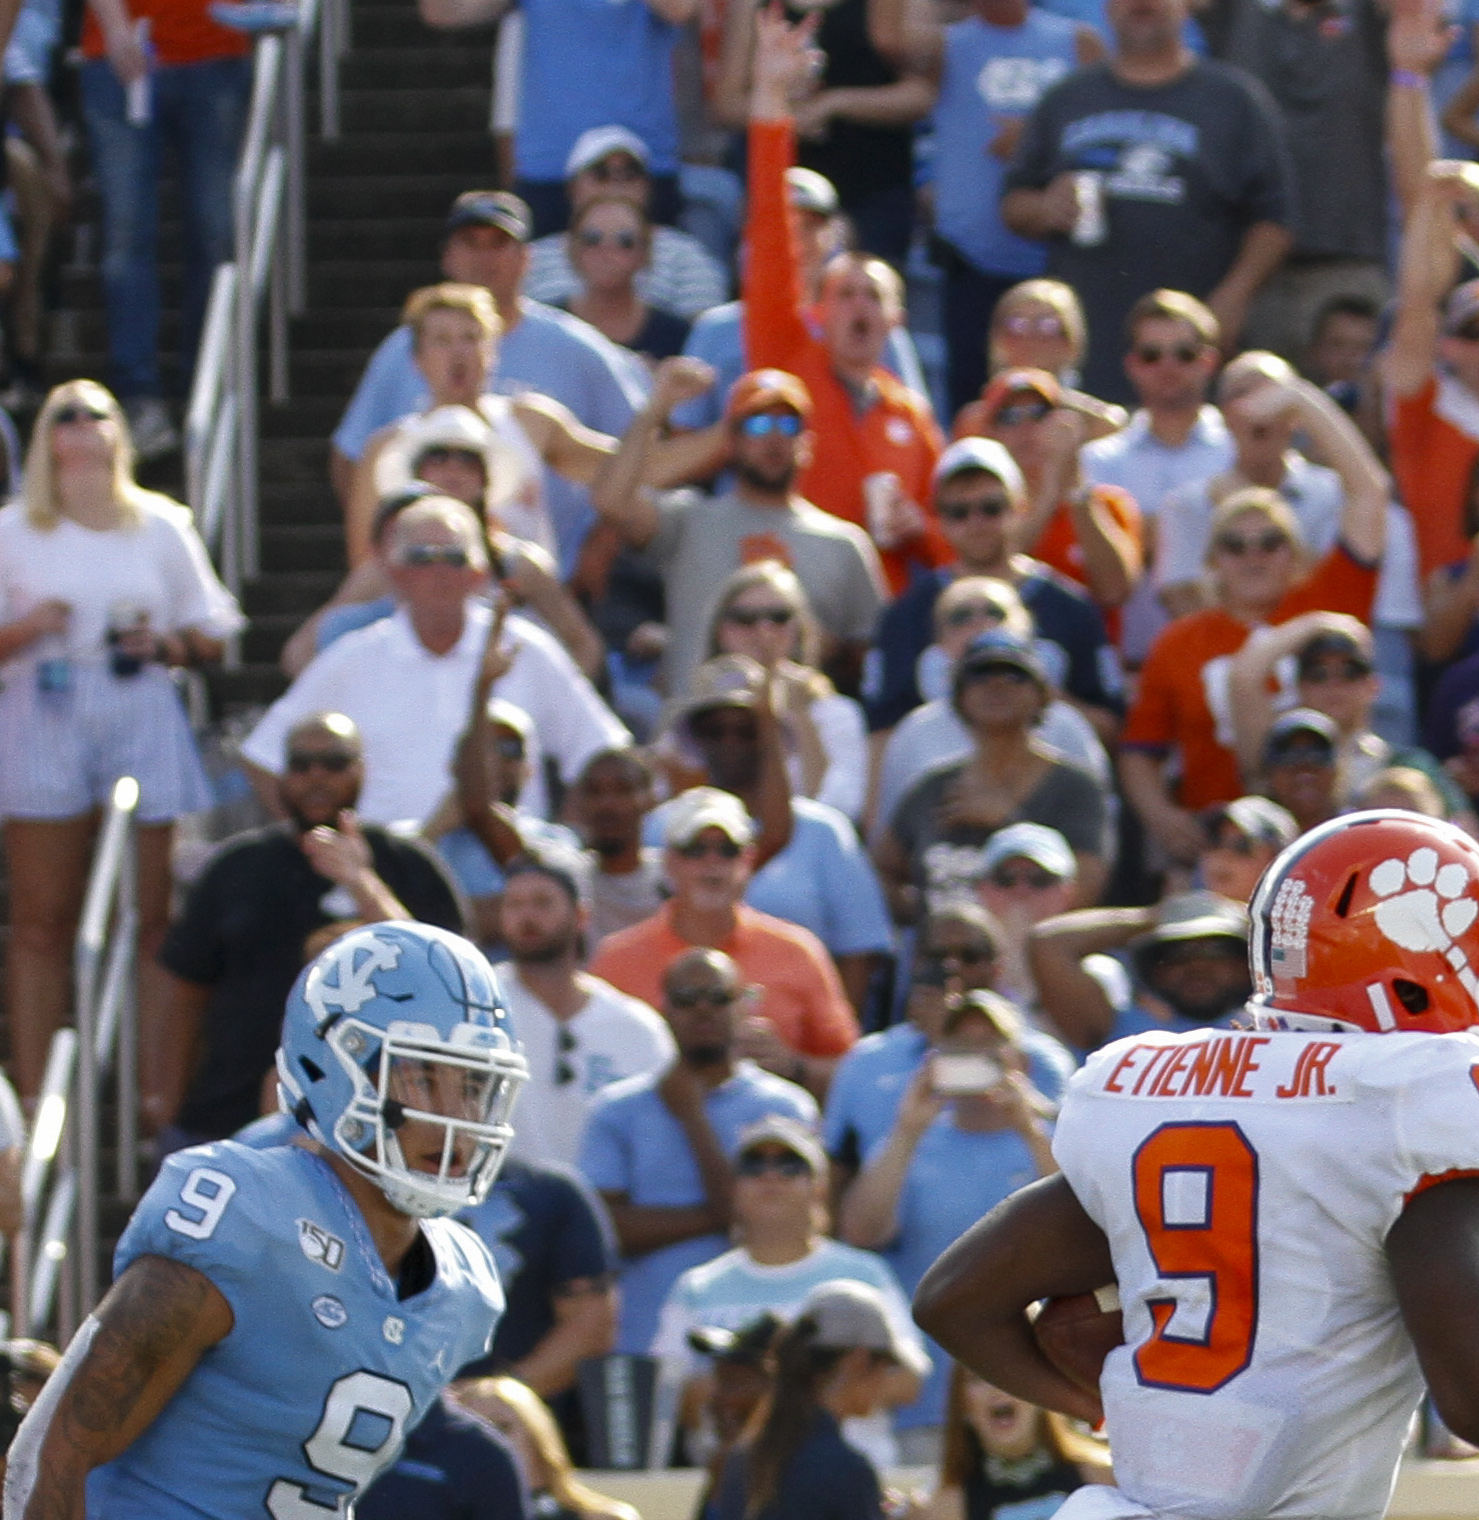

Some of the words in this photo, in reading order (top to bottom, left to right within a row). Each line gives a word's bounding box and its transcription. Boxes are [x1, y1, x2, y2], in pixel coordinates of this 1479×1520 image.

[1103, 1037, 1272, 1097] ETIENNE
[1275, 1041, 1343, 1098] JR.
[163, 1166, 237, 1240] 9
[1131, 1120, 1259, 1394] 9
